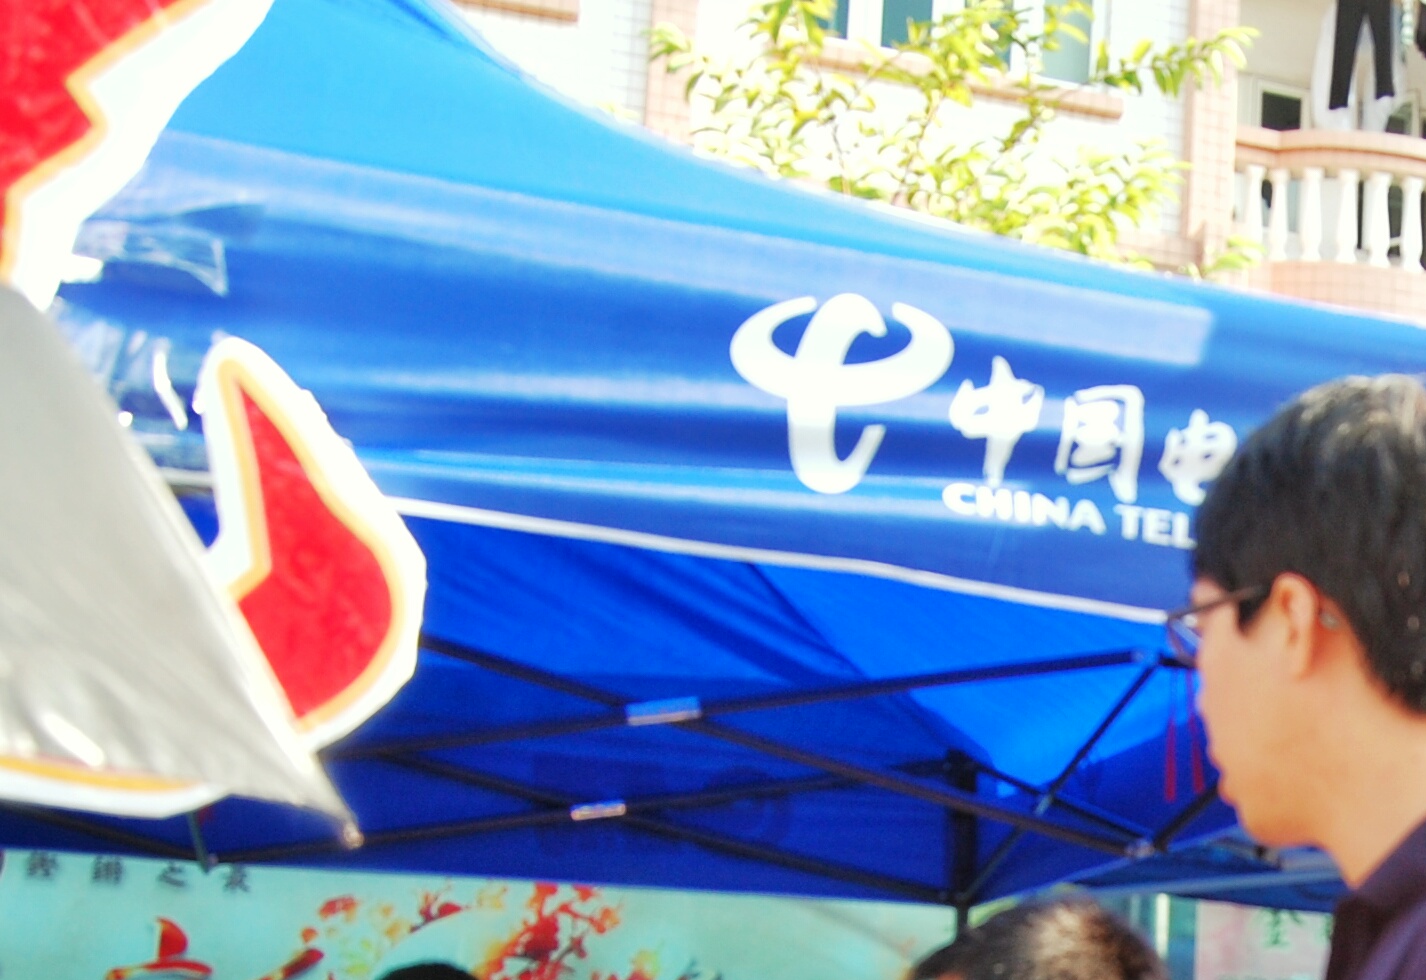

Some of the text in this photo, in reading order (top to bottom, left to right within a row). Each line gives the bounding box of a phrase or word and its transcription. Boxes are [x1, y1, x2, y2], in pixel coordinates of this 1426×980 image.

[948, 356, 1239, 505] 中国电
[941, 482, 1197, 550] CHINA TEL
